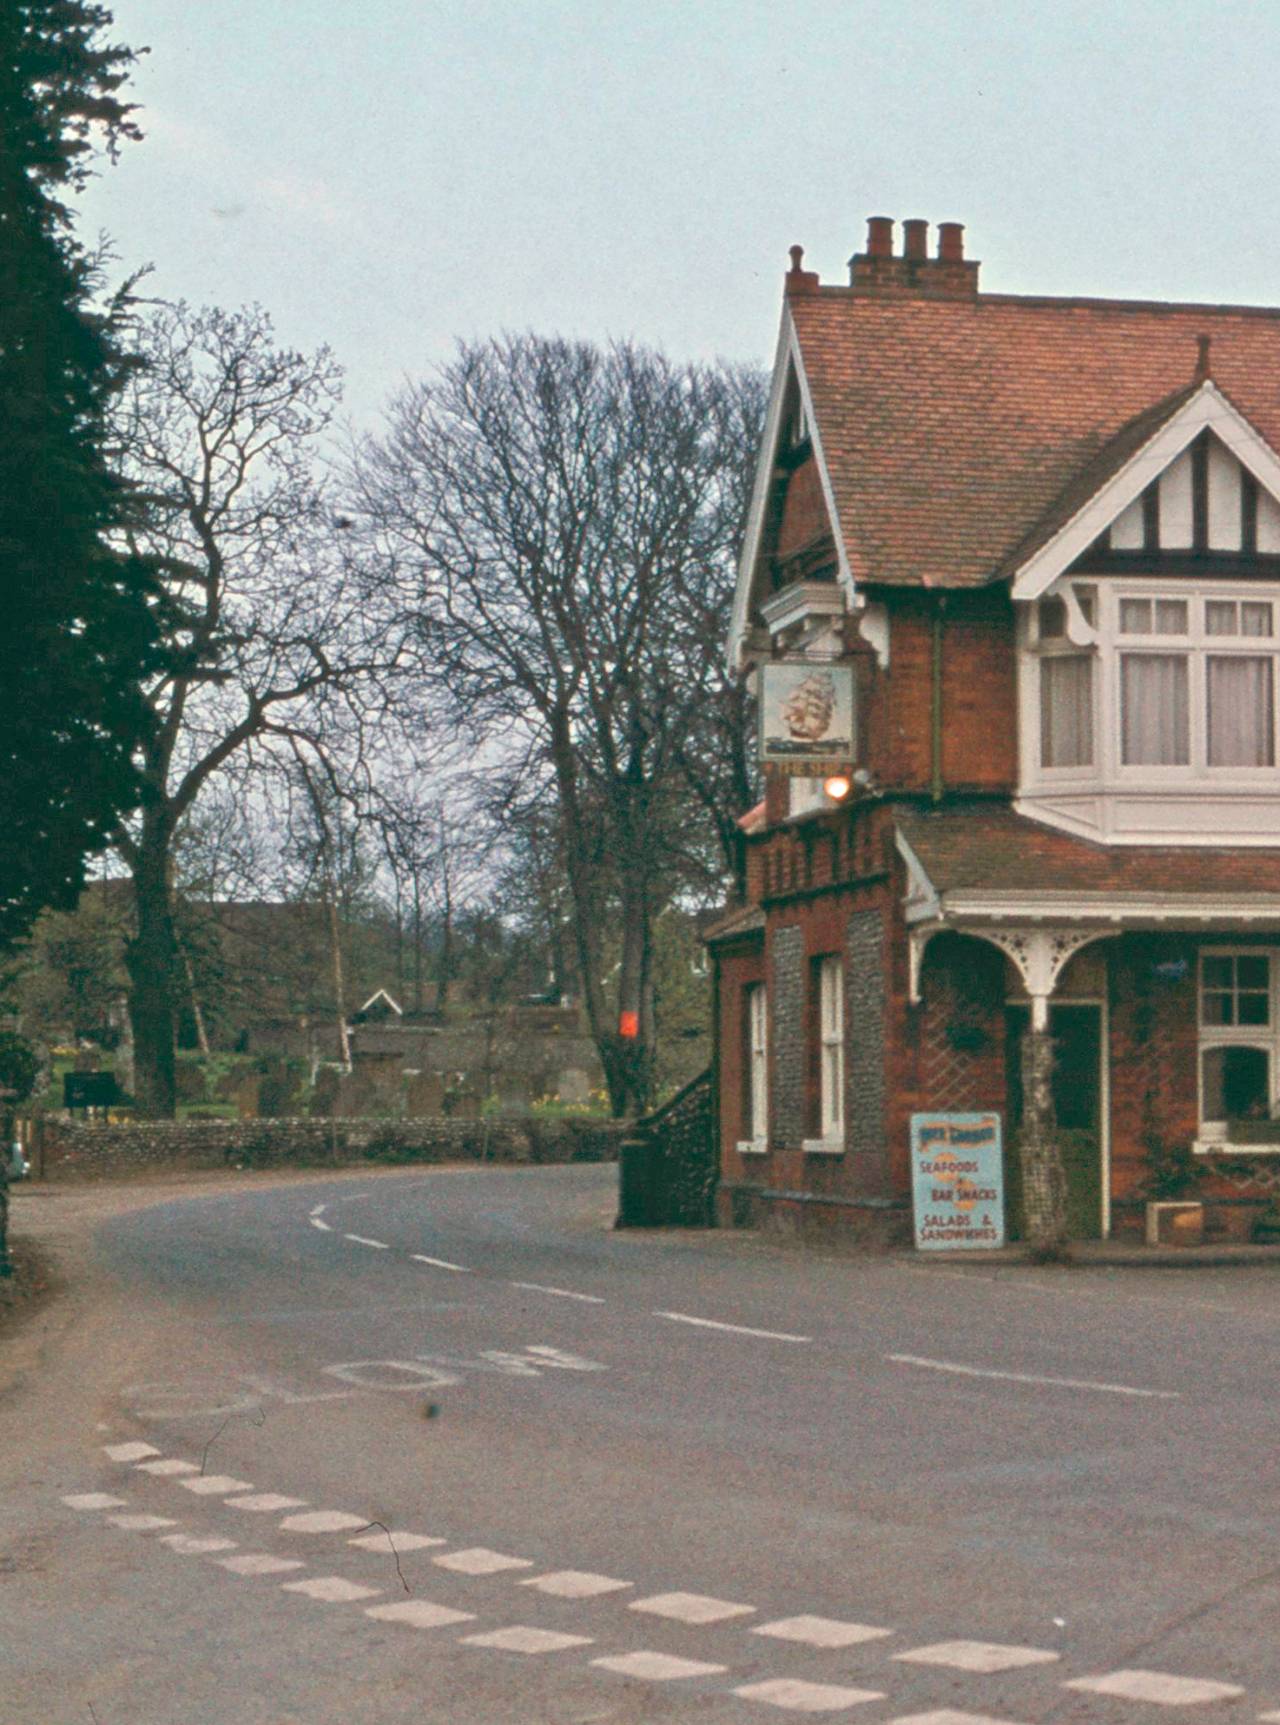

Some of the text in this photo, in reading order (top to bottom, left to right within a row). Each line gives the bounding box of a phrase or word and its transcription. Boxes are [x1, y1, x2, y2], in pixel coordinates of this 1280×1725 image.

[920, 1161, 978, 1173] SEAFOODS
[931, 1188, 997, 1201] BAR SNACKS
[924, 1213, 992, 1226] SALADS &
